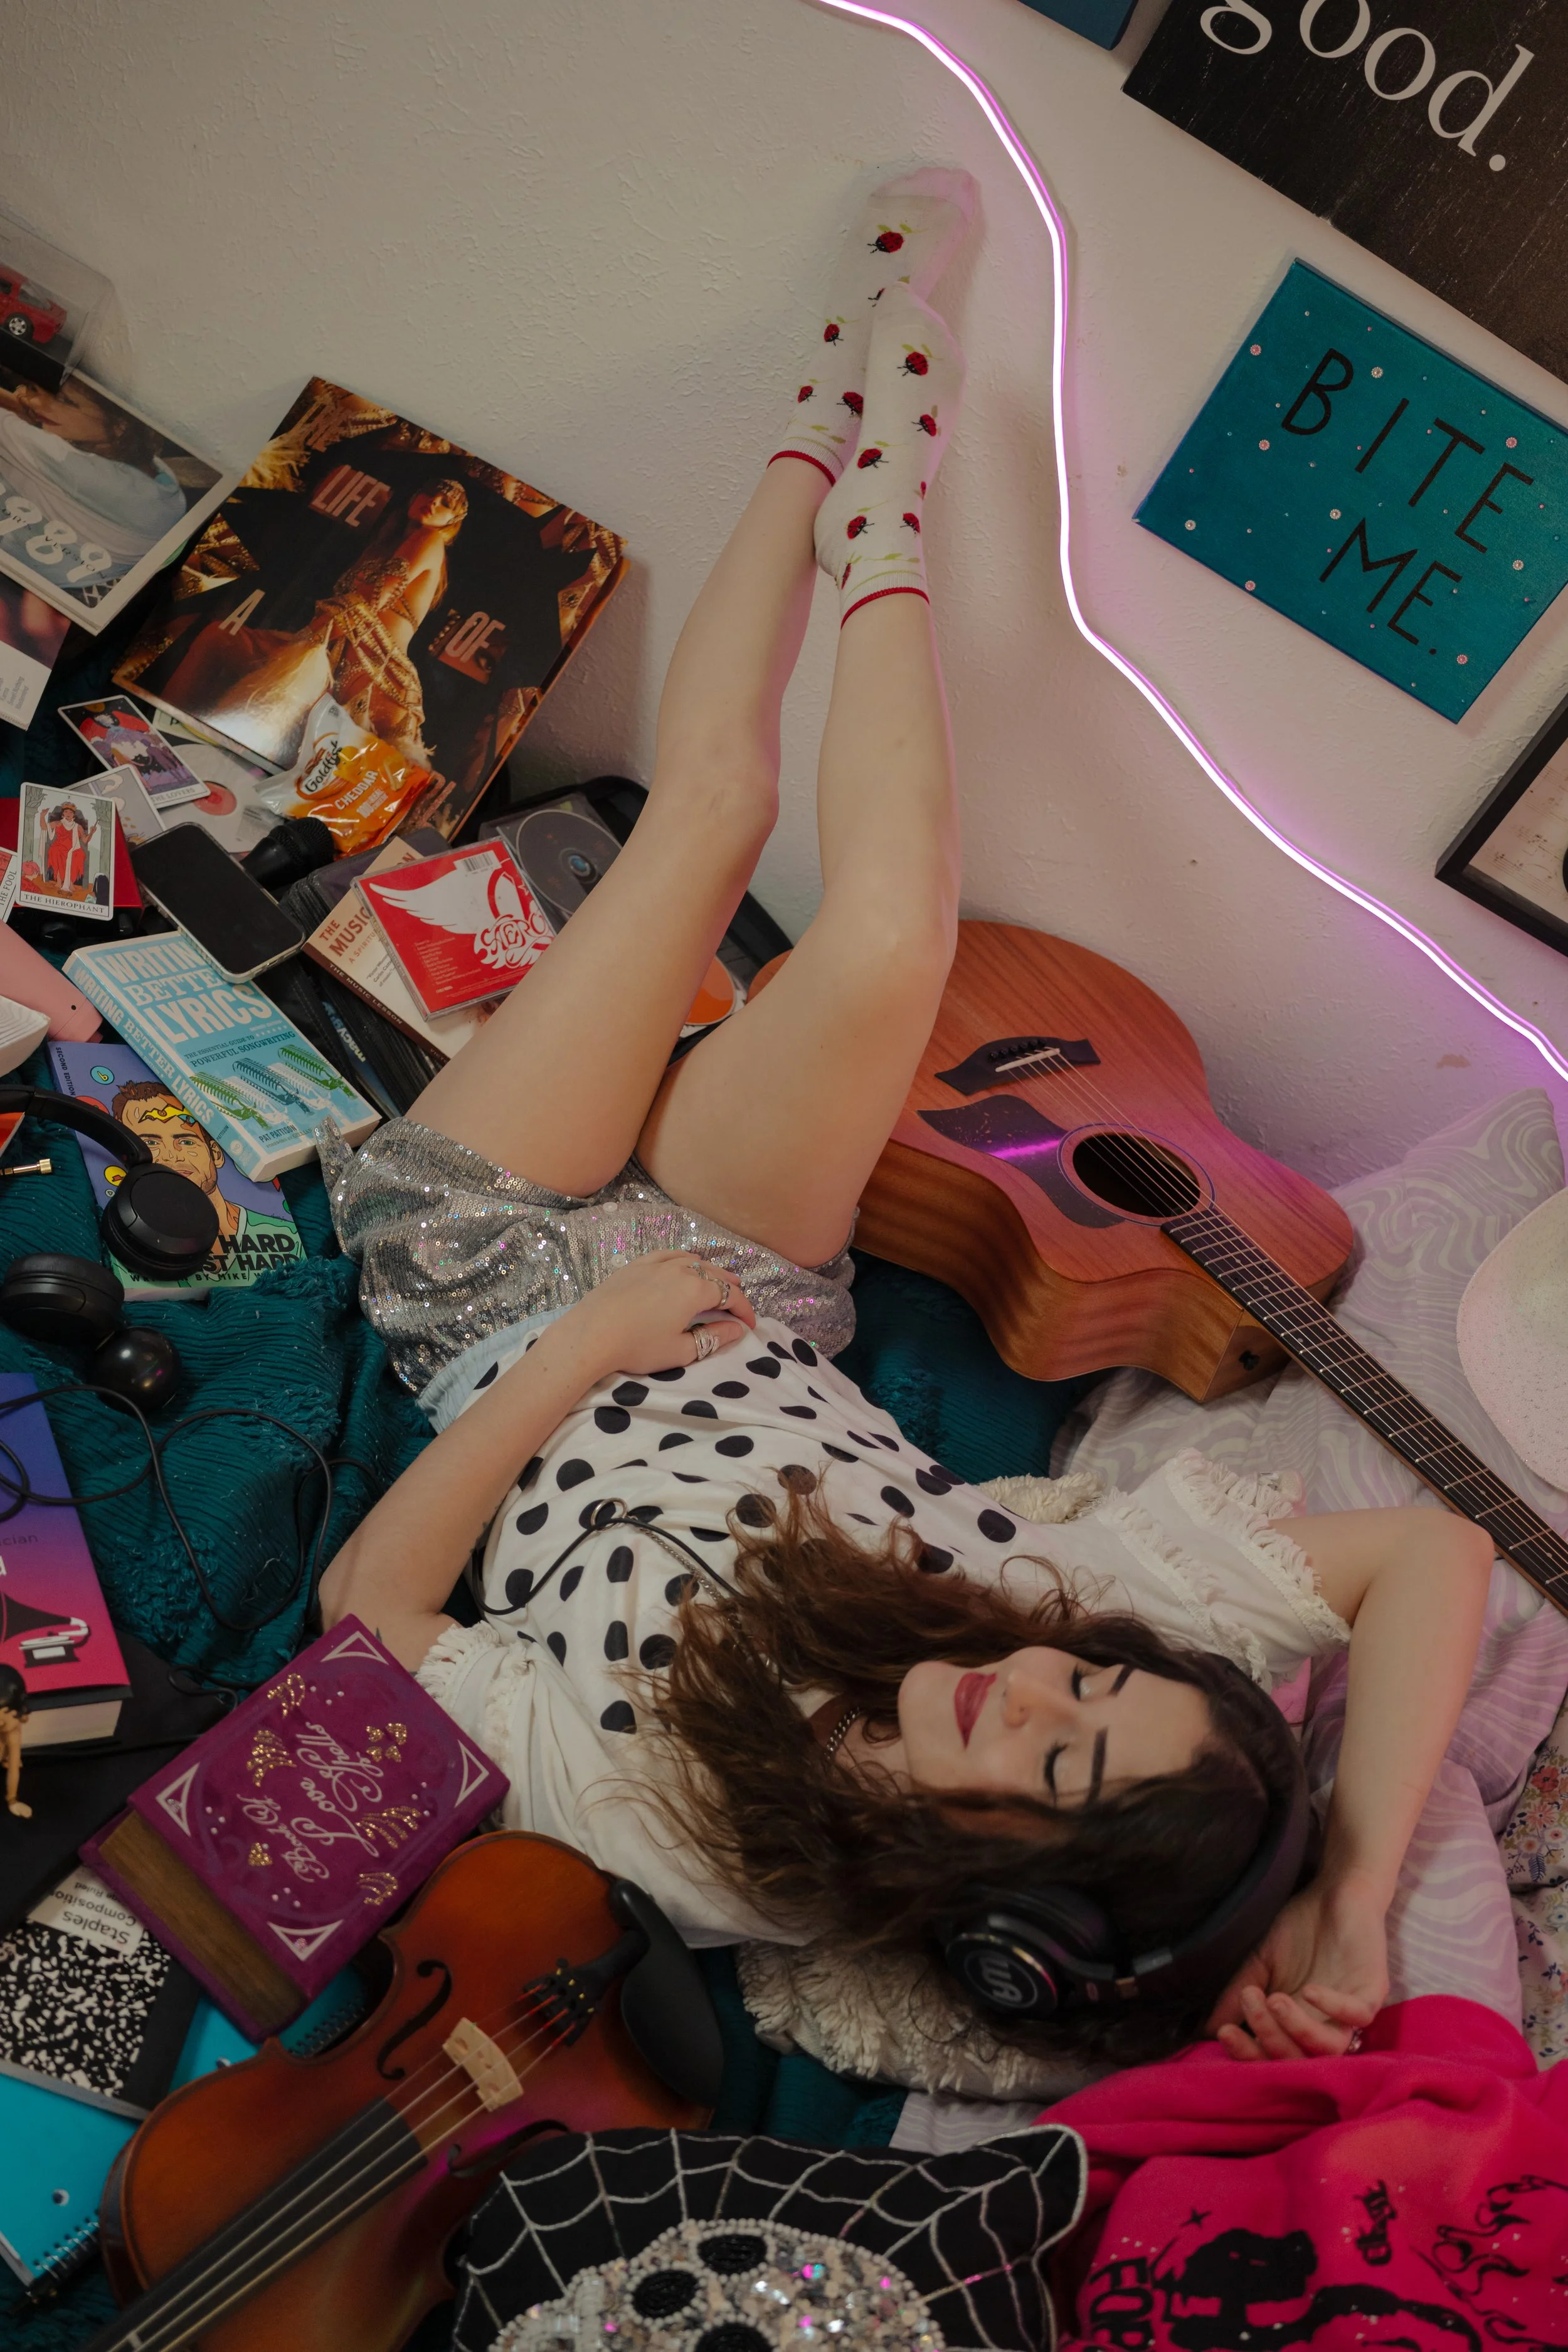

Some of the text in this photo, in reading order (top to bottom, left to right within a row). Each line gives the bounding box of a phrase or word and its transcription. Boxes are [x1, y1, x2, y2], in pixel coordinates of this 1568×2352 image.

[1281, 348, 1535, 554] BITE
[309, 465, 391, 527] LIFE
[1319, 517, 1463, 655] ME.
[221, 589, 265, 636] A
[445, 612, 506, 663] OF
[334, 770, 379, 810] CHEDDAR
[3, 871, 17, 891] FOOL
[24, 894, 105, 913] THE HIEROPHANT
[319, 919, 341, 942] THE
[329, 906, 371, 958] MUSIC
[95, 940, 207, 985] WRITIN
[349, 956, 356, 965] A
[124, 968, 224, 1007] BETTE
[329, 964, 345, 977] THE
[346, 977, 371, 999] MUSIC
[373, 999, 403, 1025] LESSON
[144, 984, 273, 1045] LYRICS
[73, 967, 125, 1027] WRITING
[124, 1016, 176, 1079] BETTER
[172, 1078, 215, 1125] LYRICS
[184, 1035, 255, 1060] THE ESSENTIAL GUIDE TO
[190, 1030, 297, 1067] POWERFUL SONGWRITING
[55, 1047, 76, 1096] SECOND EDITION
[258, 1124, 297, 1143] PAT PATTISON
[218, 1234, 295, 1253] HARD
[220, 1272, 248, 1281] MIKE
[295, 1721, 384, 1812] Spells
[290, 1777, 379, 1858] Love
[267, 1821, 331, 1883] Book
[75, 1882, 104, 1898] Ruled
[62, 1911, 131, 1944] Staples
